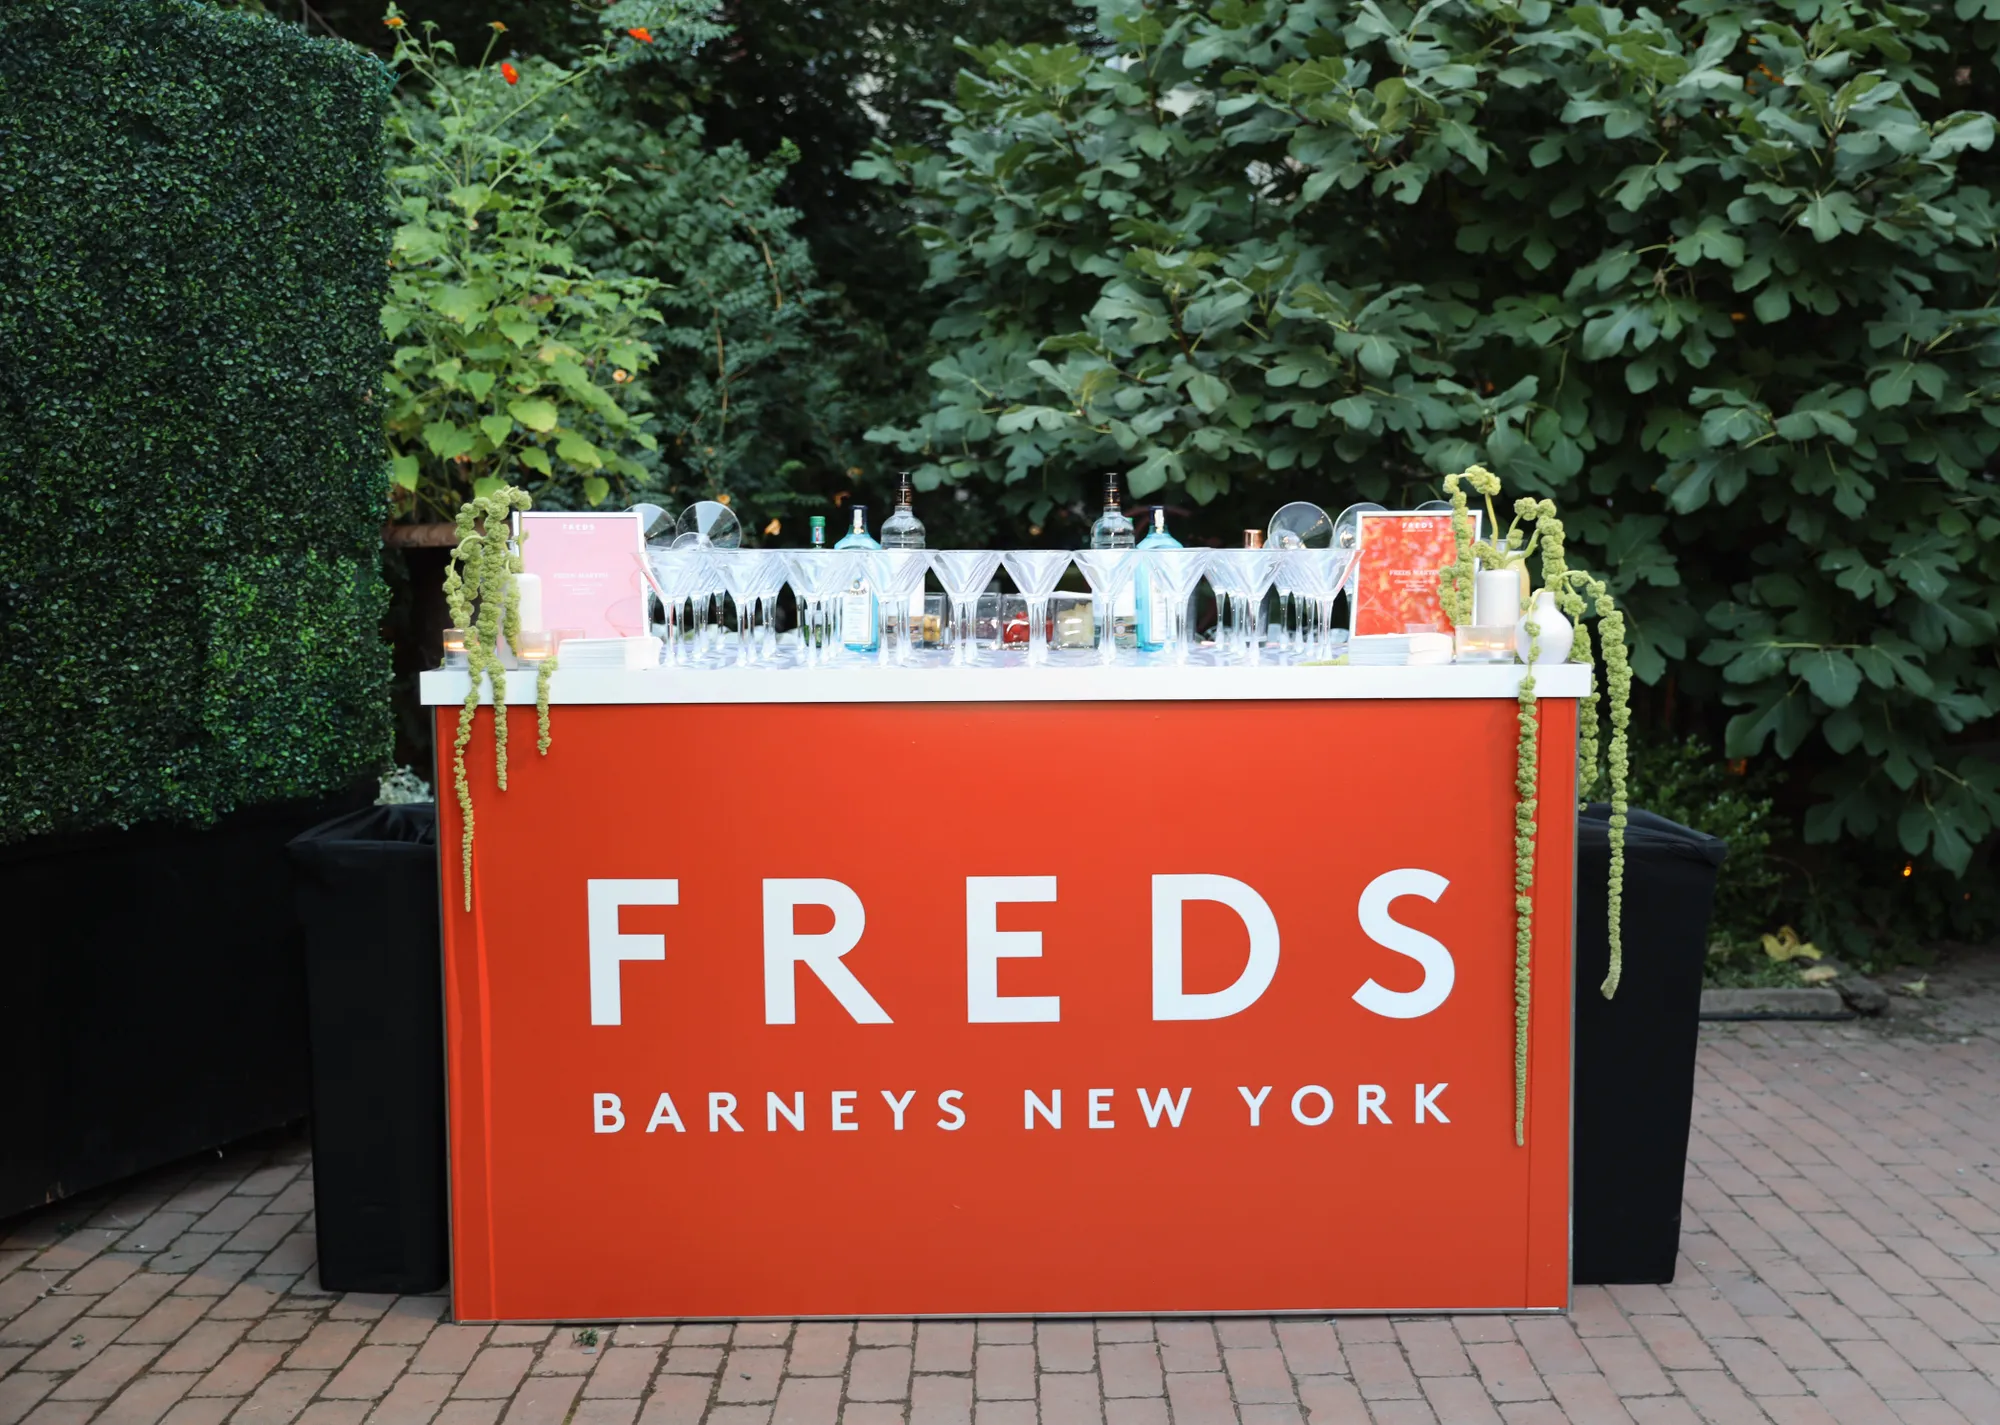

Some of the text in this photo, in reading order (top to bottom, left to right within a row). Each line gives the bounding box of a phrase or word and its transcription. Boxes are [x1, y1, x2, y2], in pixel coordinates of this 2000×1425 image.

[1402, 521, 1434, 529] FREDS
[587, 868, 1456, 1026] FREDS
[593, 1082, 1451, 1134] BARNEYS NEW YORK
